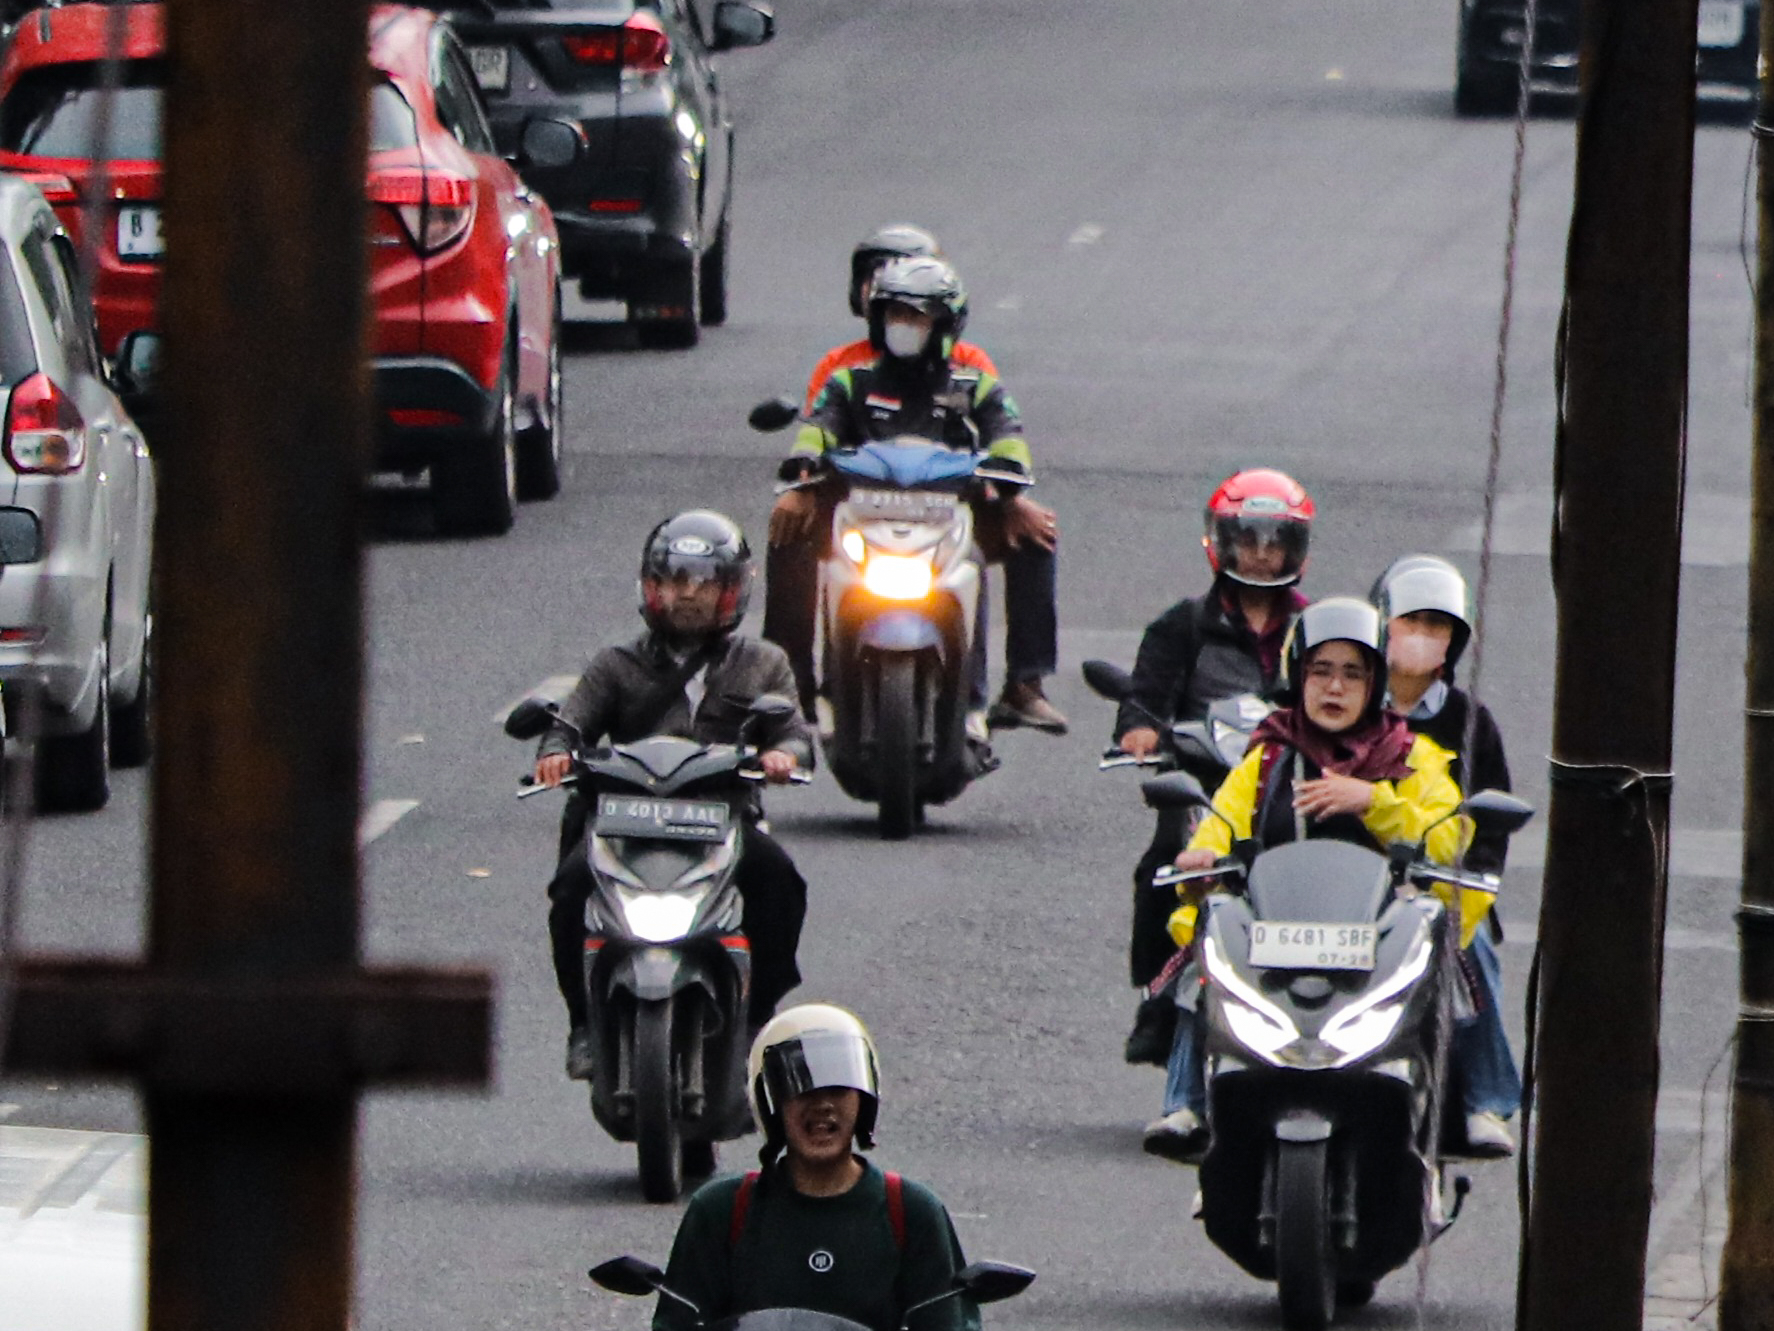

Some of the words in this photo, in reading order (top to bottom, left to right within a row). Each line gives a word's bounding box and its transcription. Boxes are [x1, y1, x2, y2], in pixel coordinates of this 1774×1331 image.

[605, 802, 617, 816] D
[683, 804, 720, 824] AAL
[1254, 927, 1266, 944] D
[1278, 928, 1325, 946] 6481
[1337, 929, 1372, 947] SBF
